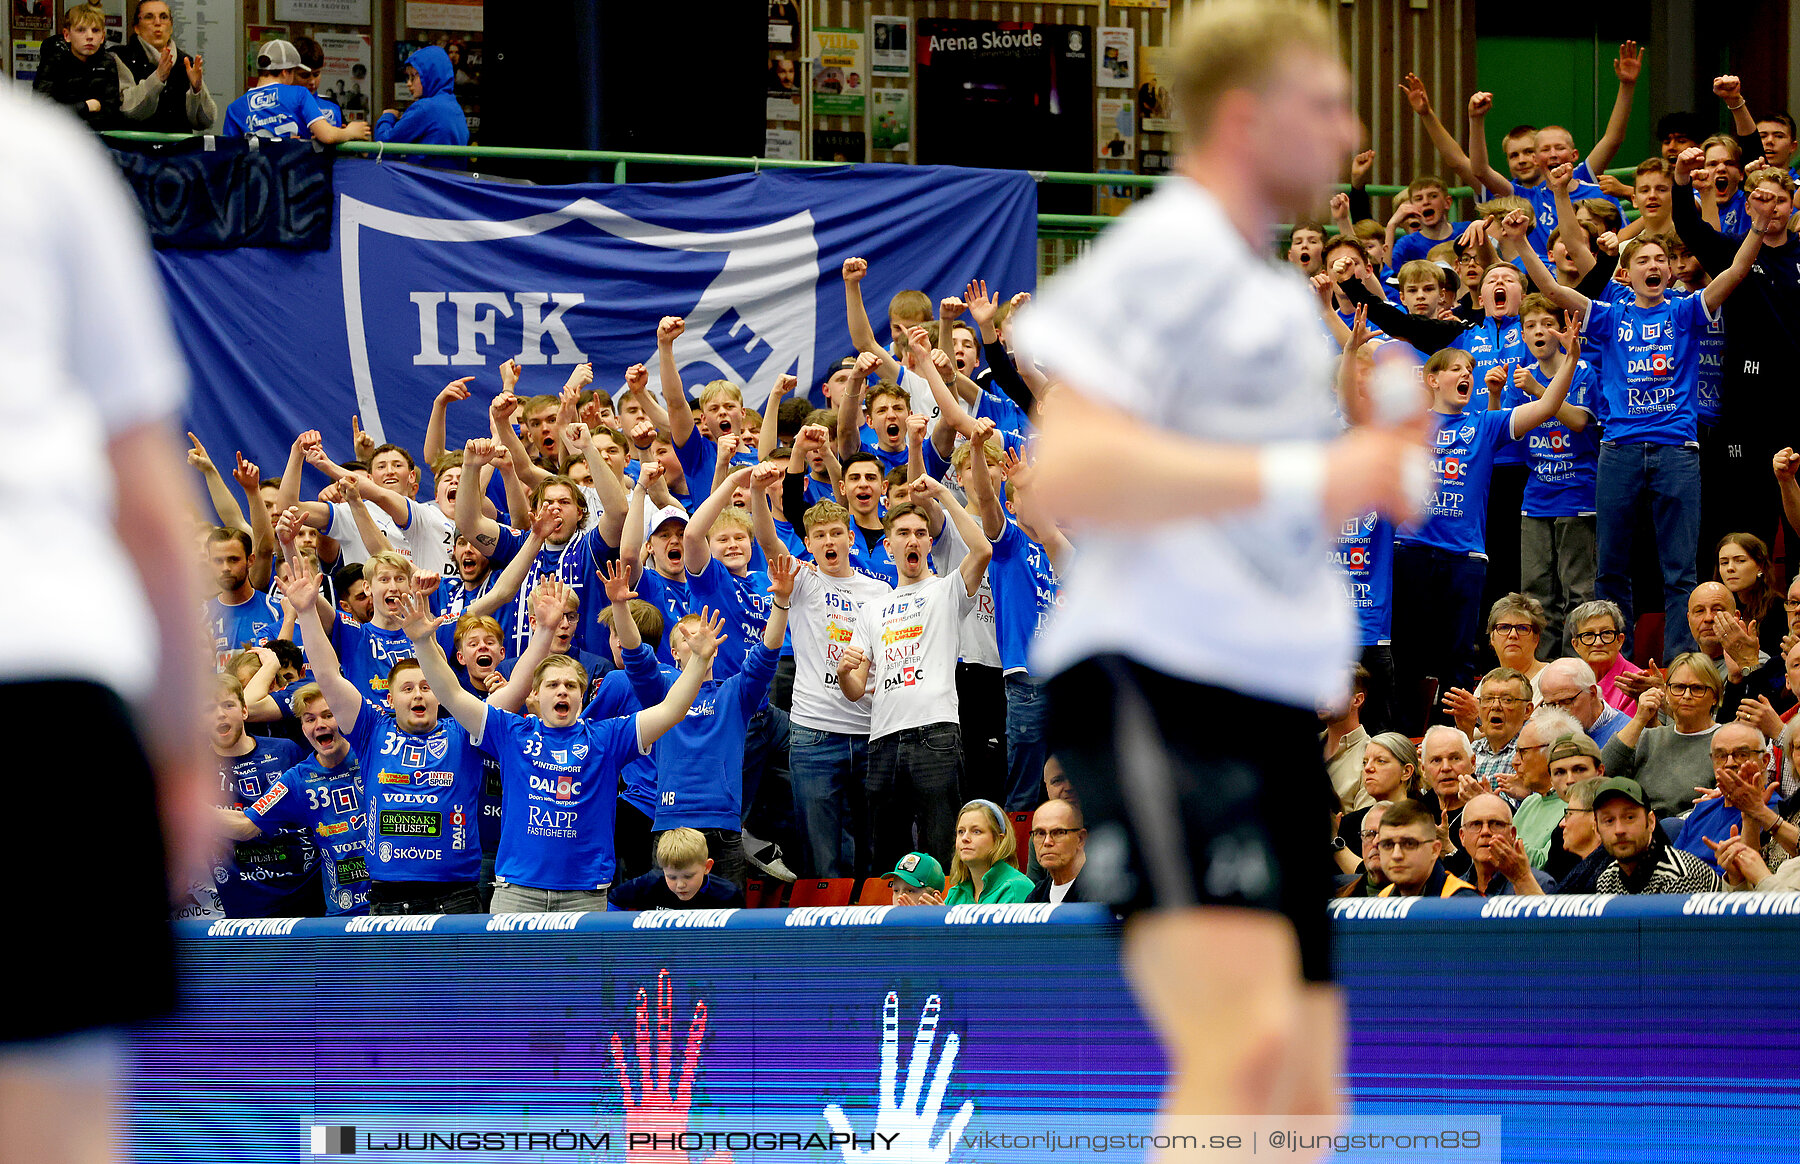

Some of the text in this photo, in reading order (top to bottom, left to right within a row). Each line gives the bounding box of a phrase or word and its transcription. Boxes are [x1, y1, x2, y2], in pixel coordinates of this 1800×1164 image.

[929, 29, 1043, 52] Arena Skövde
[1538, 212, 1554, 227] 45
[411, 290, 589, 366] IFK
[1617, 327, 1634, 342] 90
[1477, 356, 1522, 367] BRANDT
[1627, 356, 1675, 373] DALOC
[1743, 359, 1760, 375] RH
[1626, 387, 1675, 407] RAPP
[1628, 403, 1677, 415] FASTIGHETER
[1529, 433, 1571, 449] DALOC
[1728, 444, 1742, 458] RH
[1428, 460, 1468, 476] ALOC
[1326, 551, 1371, 565] DALOC
[825, 592, 839, 608] 45
[1036, 585, 1066, 607] DALO
[882, 604, 896, 618] 14
[884, 669, 924, 690] DALOC
[380, 731, 406, 756] 37
[523, 739, 543, 757] 33
[538, 761, 582, 773] INTERSPORT
[430, 778, 452, 786] SPORT
[529, 775, 582, 795] DALOC
[252, 782, 286, 812] MAXI
[305, 786, 331, 810] 33
[382, 793, 439, 804] VOLVO
[661, 791, 676, 806] MB
[484, 804, 503, 818] SK
[528, 805, 578, 829] RAPP
[382, 813, 436, 825] GRÖNSAKS
[394, 824, 429, 833] HUSET
[452, 804, 463, 850] DALOC
[527, 826, 577, 838] FASTIGHETER
[333, 839, 367, 854] VOLV
[393, 846, 443, 860] SKÖVDE
[337, 859, 367, 874] GRÖNS
[350, 870, 370, 880] HUS
[353, 890, 368, 904] SK
